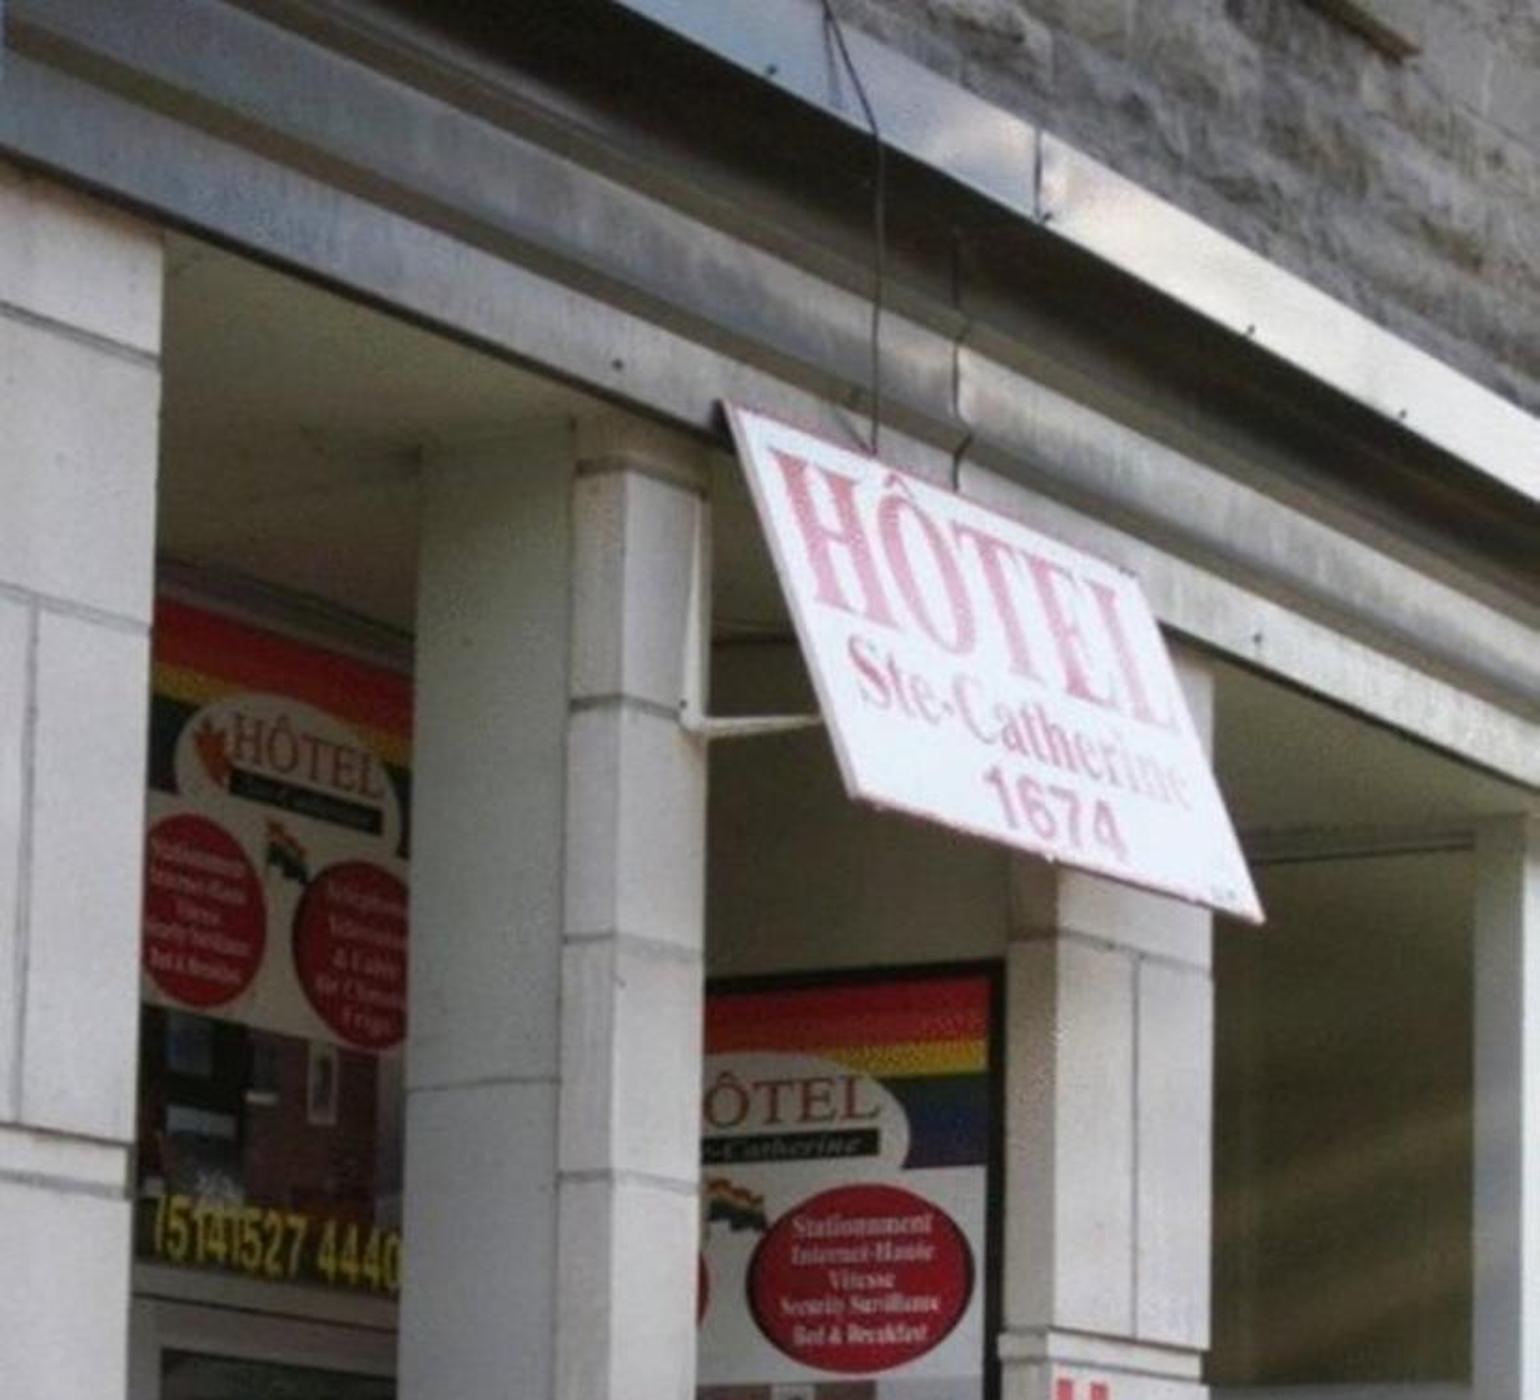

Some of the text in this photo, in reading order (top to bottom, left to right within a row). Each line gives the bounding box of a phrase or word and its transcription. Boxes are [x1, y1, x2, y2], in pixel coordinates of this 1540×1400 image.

[768, 448, 1182, 736] HÔTEL
[232, 711, 386, 800] HÔTEL
[983, 765, 1129, 860] 1674
